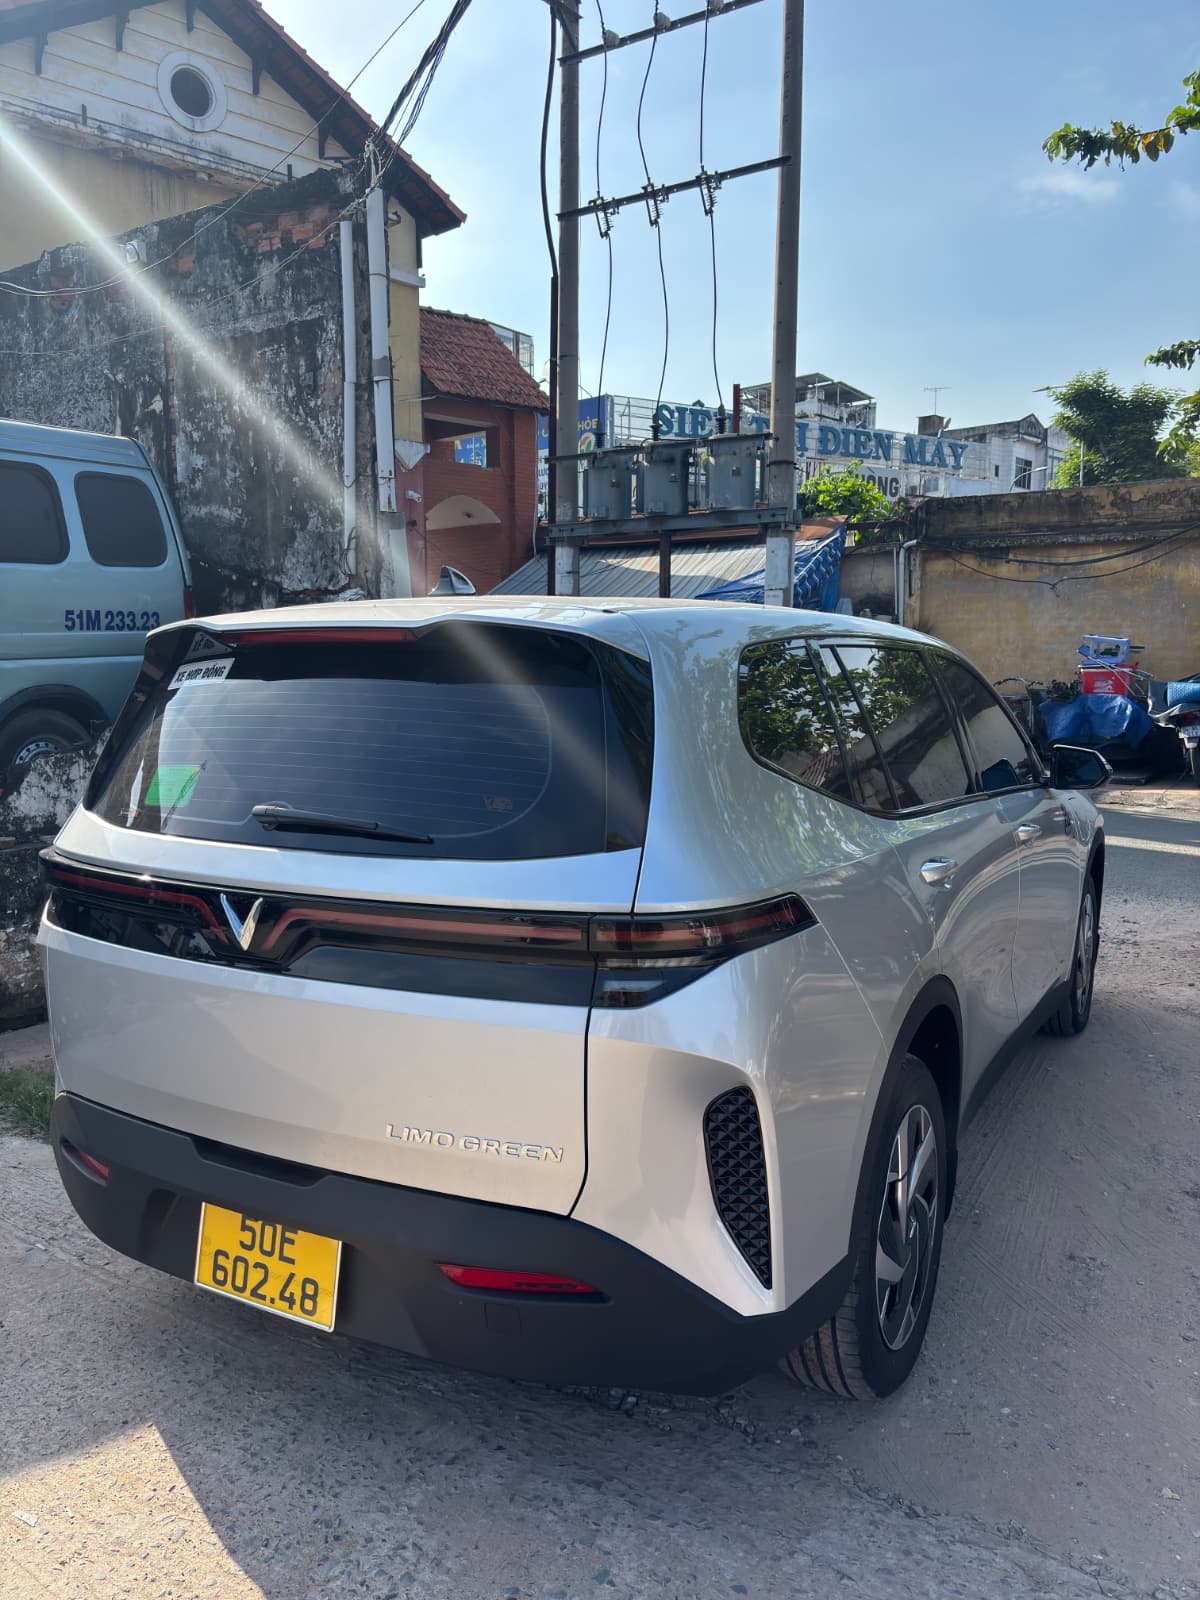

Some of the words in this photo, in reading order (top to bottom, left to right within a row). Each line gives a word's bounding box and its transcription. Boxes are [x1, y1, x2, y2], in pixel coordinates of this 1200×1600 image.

[577, 416, 598, 431] HỎE
[747, 414, 809, 458] TỊ
[903, 428, 968, 470] MÁY
[64, 609, 101, 631] 51M
[104, 610, 160, 631] 233.23
[175, 671, 187, 683] XE
[385, 1123, 455, 1148] LIMO
[459, 1135, 565, 1163] GREEN
[239, 1214, 298, 1265] 50E
[212, 1249, 319, 1317] 602.48
